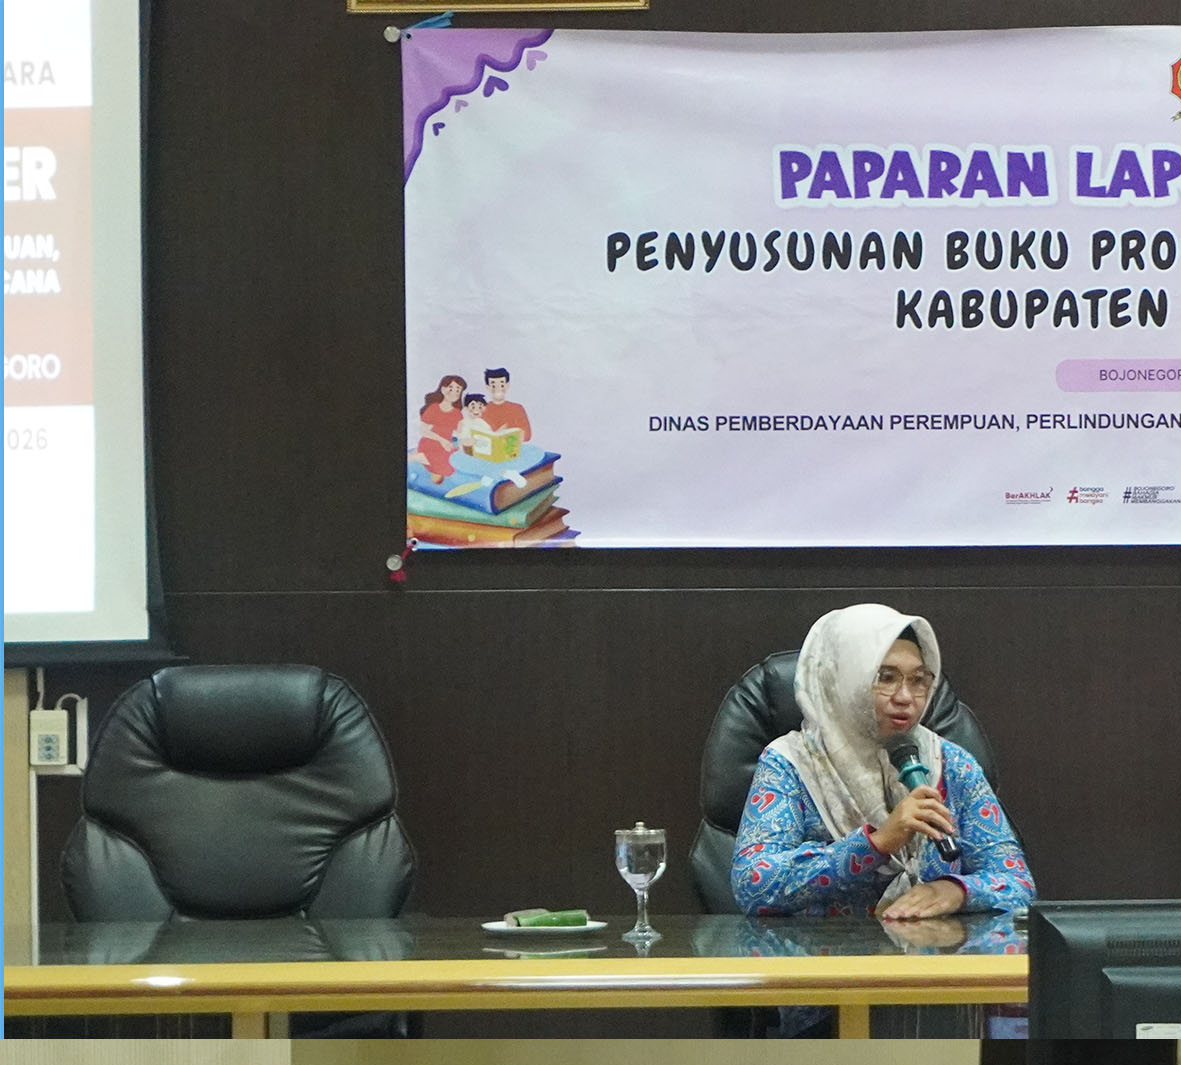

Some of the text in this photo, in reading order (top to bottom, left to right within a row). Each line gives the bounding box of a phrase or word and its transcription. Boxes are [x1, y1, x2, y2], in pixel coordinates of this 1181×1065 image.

[780, 151, 1048, 199] PAPARAN
[606, 230, 923, 273] PENYUSUNAN
[946, 230, 1069, 270] BUKU
[896, 288, 1168, 330] KABUPATEN
[650, 415, 709, 432] DINAS
[716, 414, 884, 432] PEMBERDAYAAN
[890, 414, 1020, 432] PEREMPUAN,
[1005, 491, 1052, 499] BerAKHLAK
